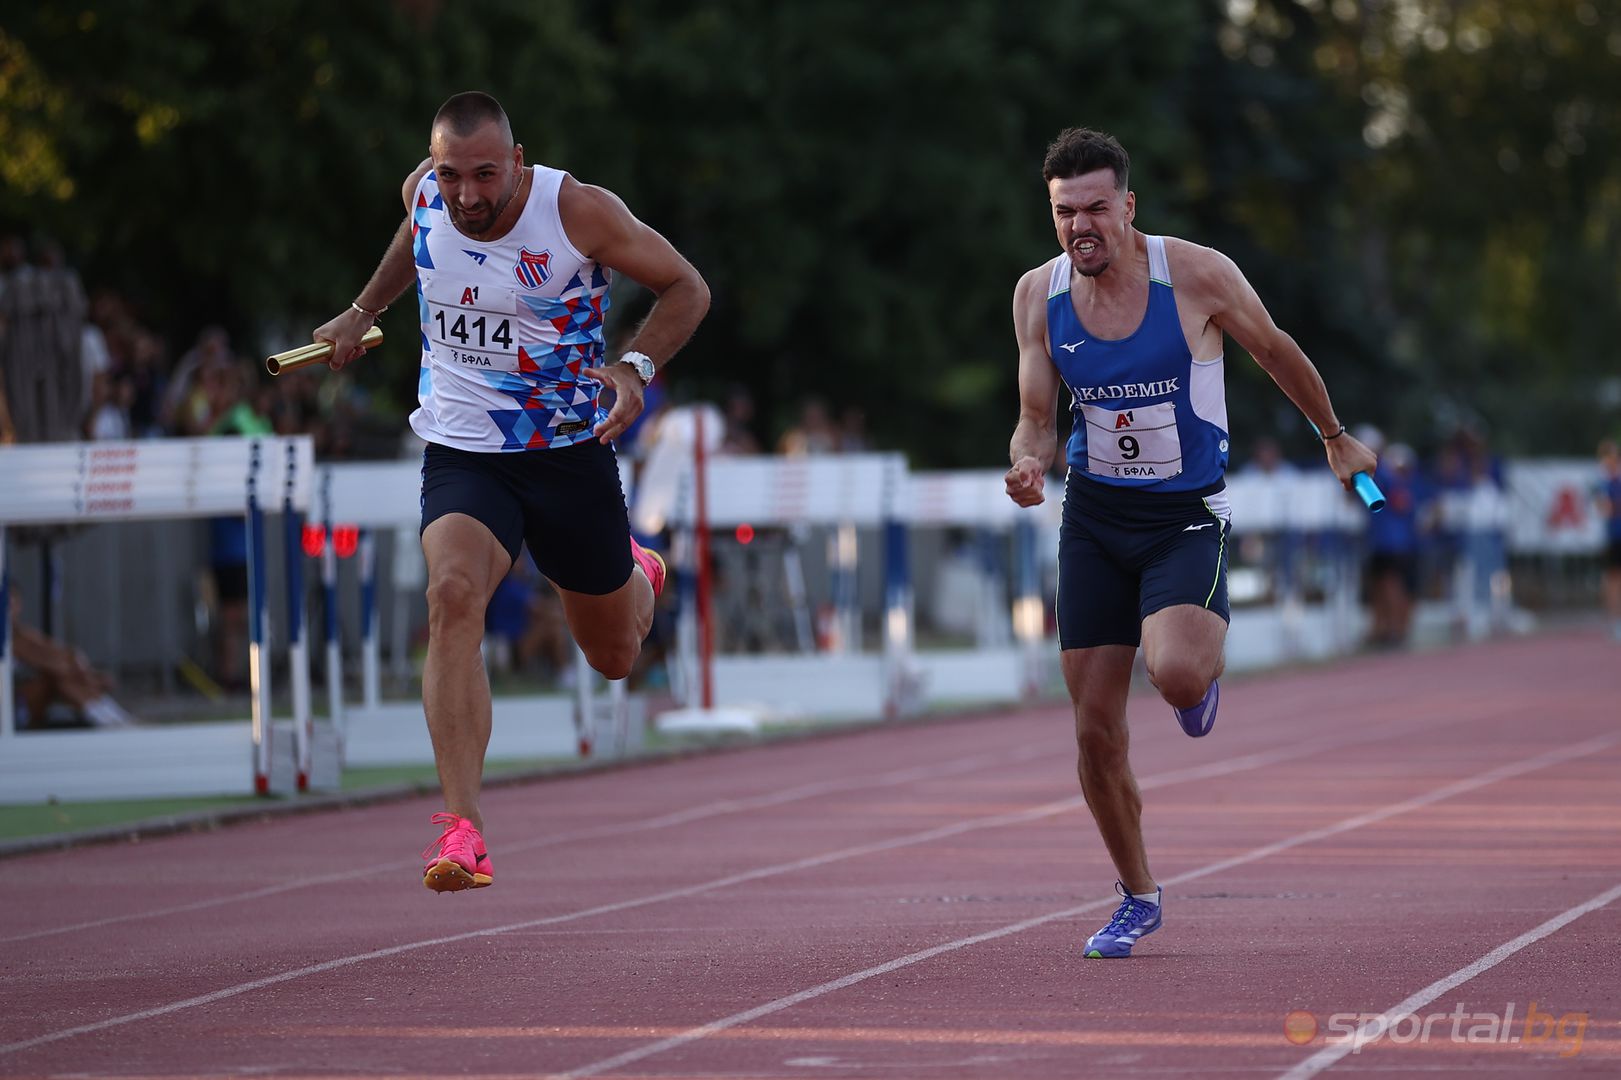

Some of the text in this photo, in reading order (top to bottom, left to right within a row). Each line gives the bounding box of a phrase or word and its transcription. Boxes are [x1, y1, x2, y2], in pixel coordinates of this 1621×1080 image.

[460, 286, 479, 305] A1
[435, 310, 513, 350] 1414
[461, 353, 492, 367] БФЛА
[1115, 411, 1135, 429] A1
[1118, 435, 1140, 460] 9
[1123, 466, 1156, 477] БФЛА
